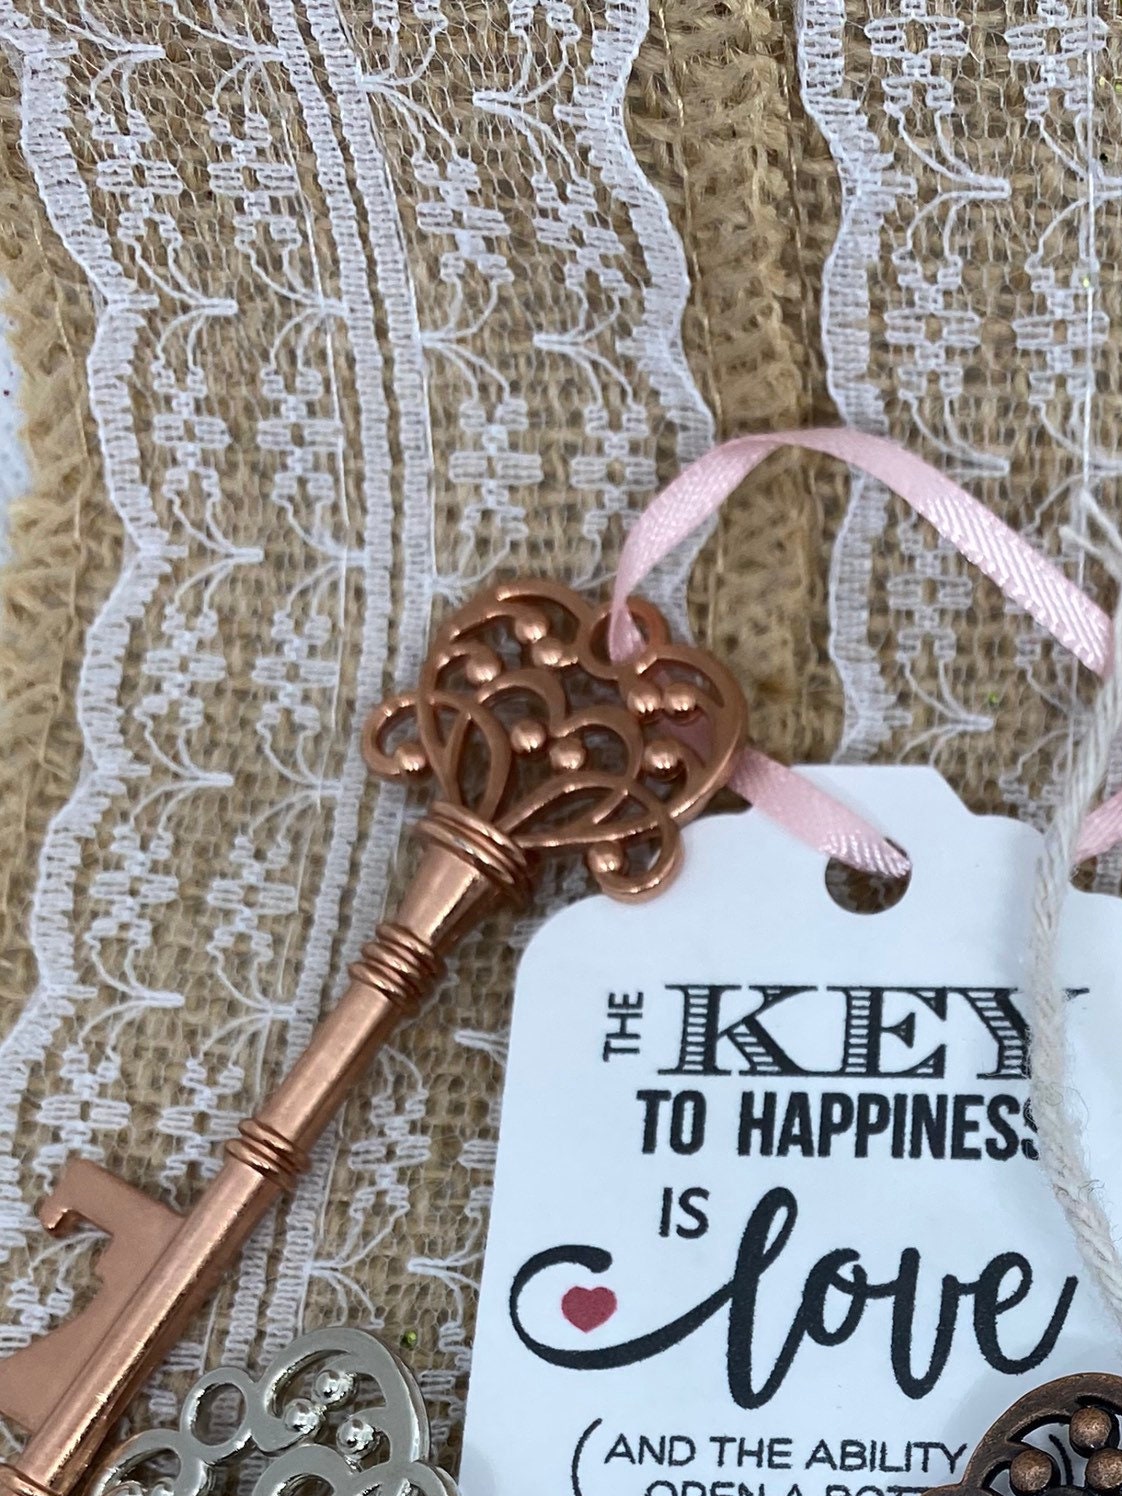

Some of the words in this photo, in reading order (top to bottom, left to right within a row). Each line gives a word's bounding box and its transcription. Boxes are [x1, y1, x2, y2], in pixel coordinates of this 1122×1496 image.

[602, 990, 645, 1063] THE
[635, 1088, 708, 1156] TO
[657, 1186, 711, 1240] IS
[507, 1185, 1080, 1410] love
[708, 1435, 794, 1471] THE
[804, 1437, 969, 1475] ABILITY
